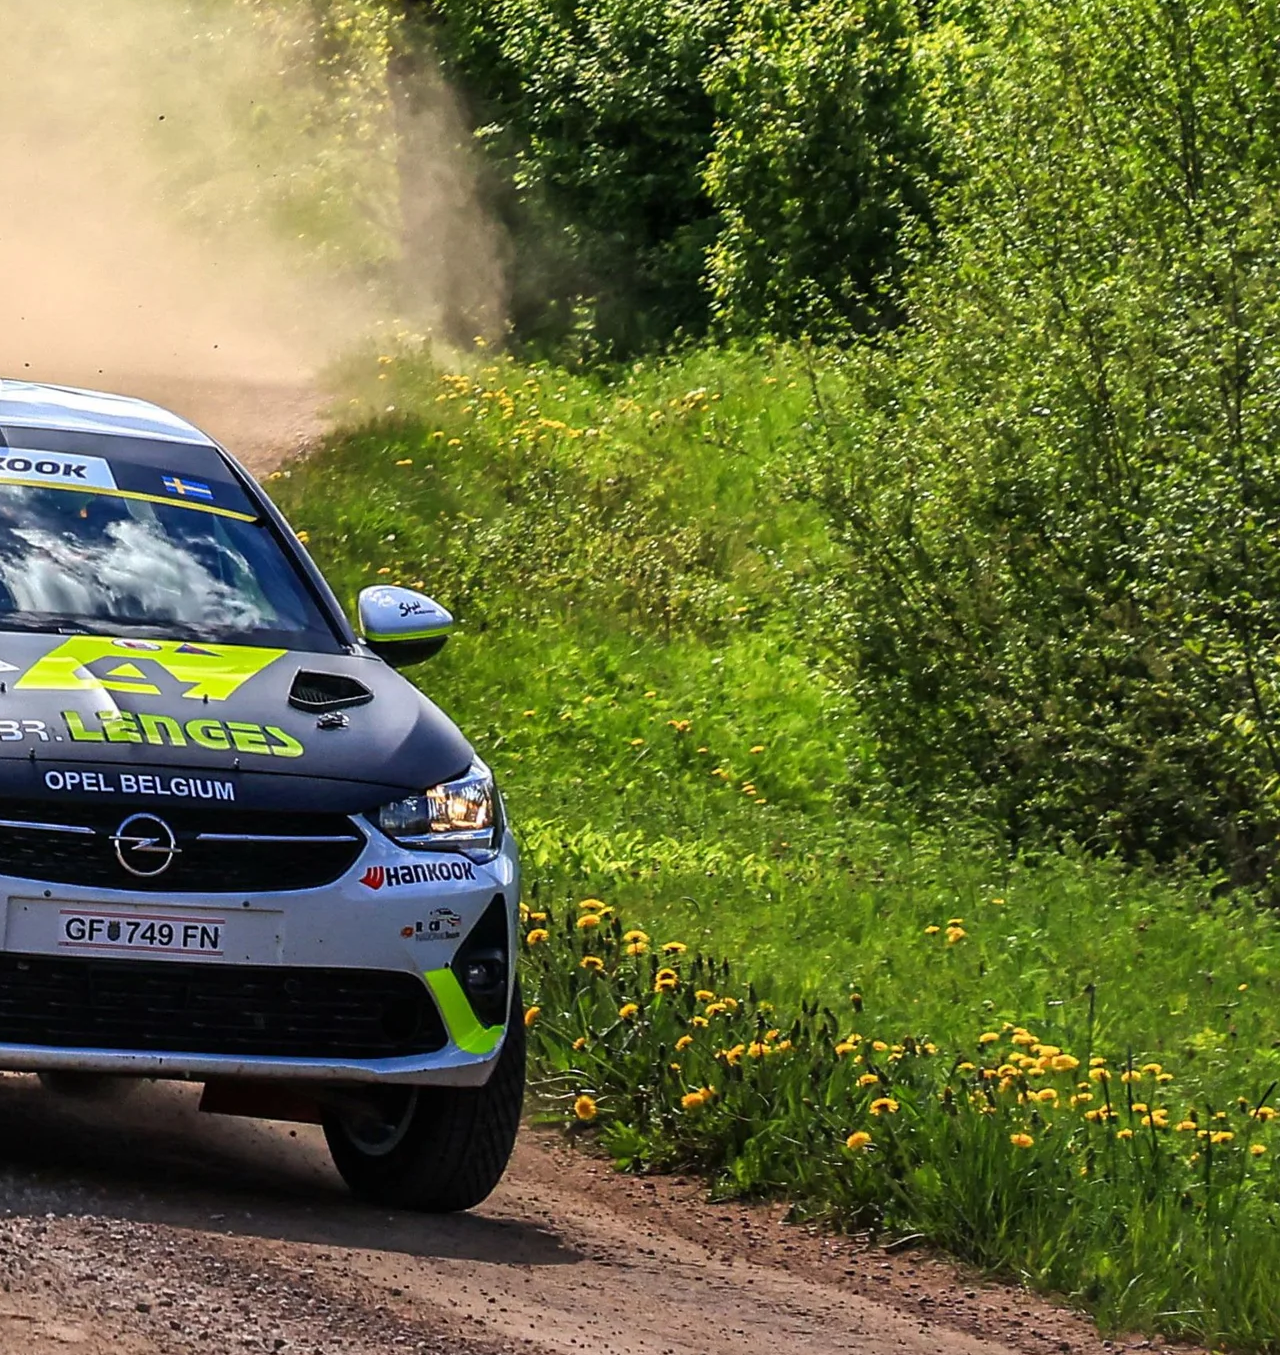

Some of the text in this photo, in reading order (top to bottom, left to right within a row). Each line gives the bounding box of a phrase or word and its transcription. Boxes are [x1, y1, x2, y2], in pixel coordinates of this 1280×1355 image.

[45, 770, 236, 801] OPEL BELGIUM
[65, 917, 220, 949] GF 749 FN
